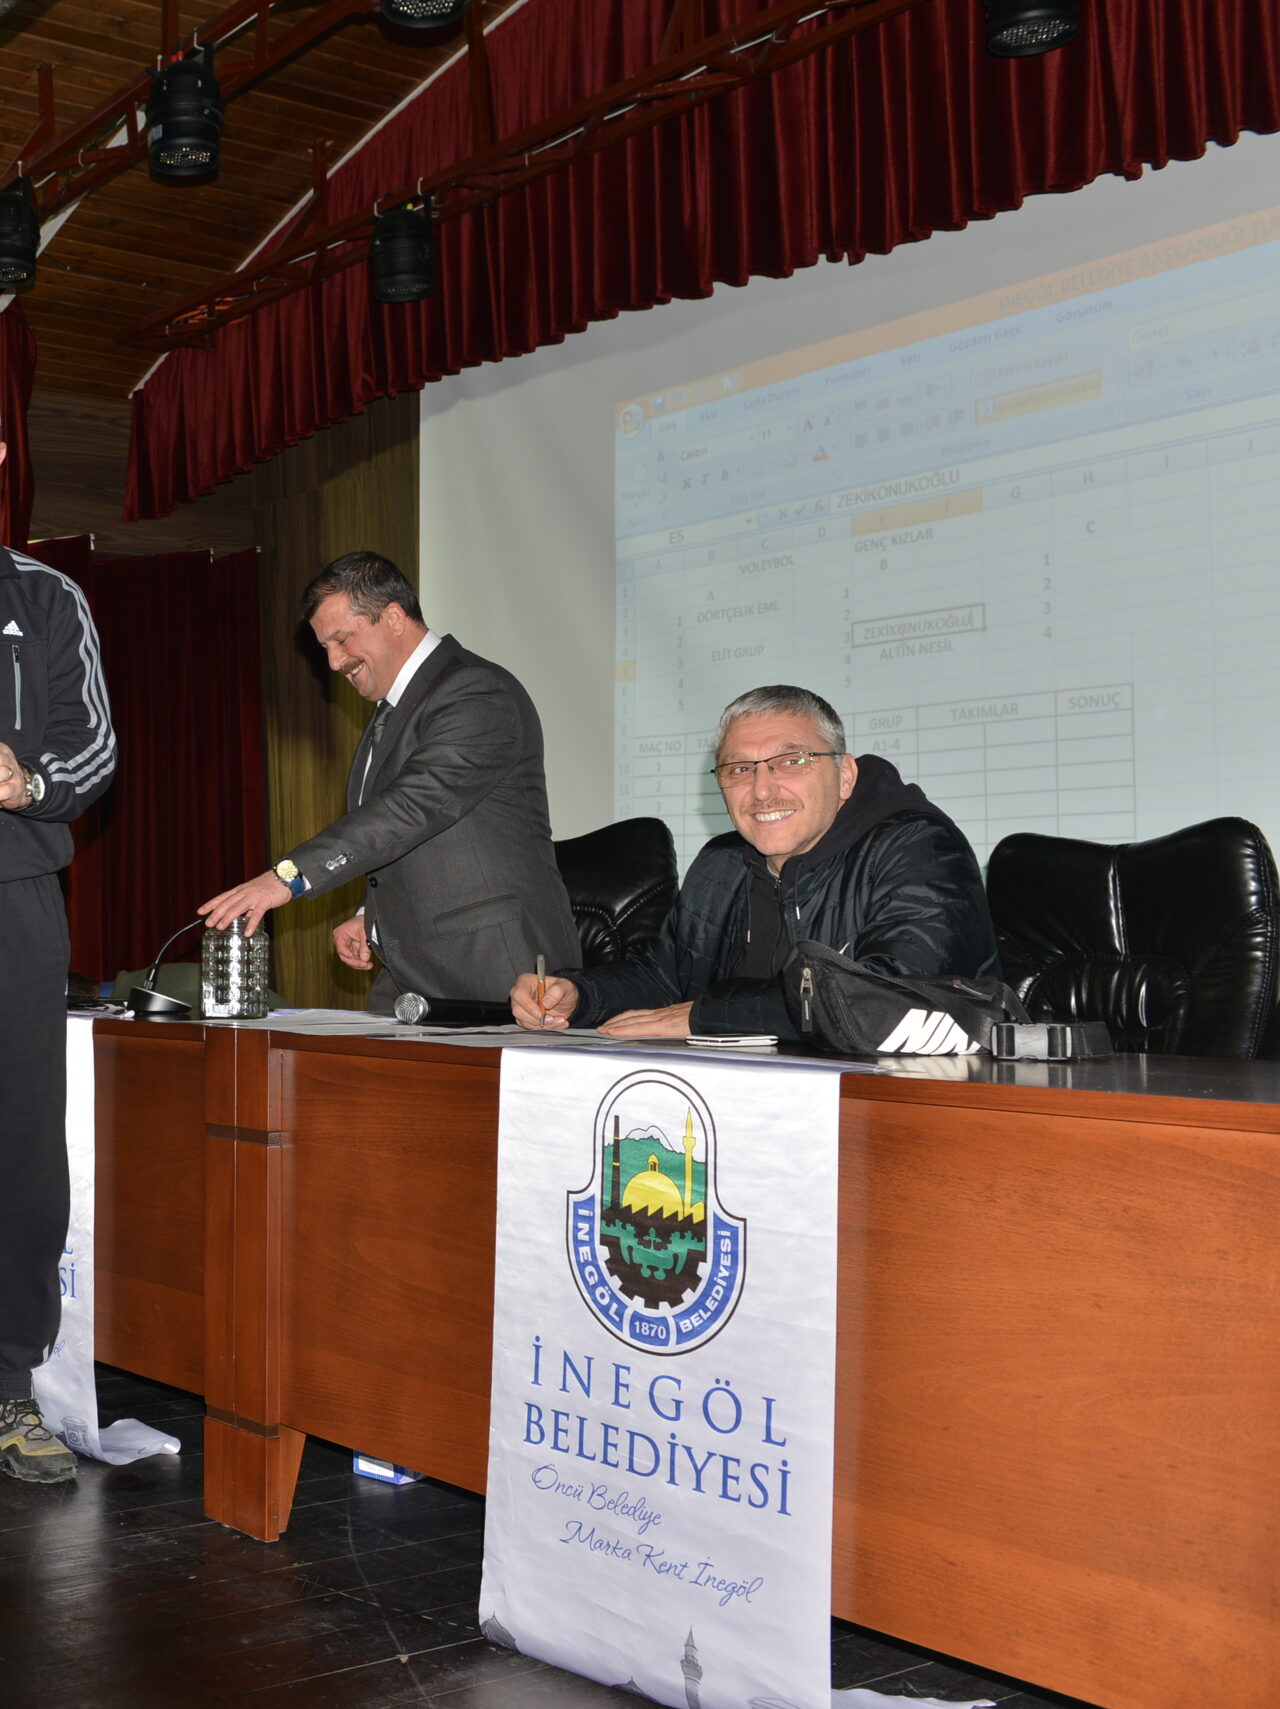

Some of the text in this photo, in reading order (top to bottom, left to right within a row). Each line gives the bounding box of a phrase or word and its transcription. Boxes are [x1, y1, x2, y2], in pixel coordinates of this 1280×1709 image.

[680, 447, 708, 462] Calibri
[837, 468, 960, 509] ZEKİKONUKOĞLU
[1086, 520, 1097, 534] C
[669, 532, 684, 544] E5
[854, 527, 934, 553] GENÇ KIZLAR
[740, 555, 795, 575] VOLEYBOL
[879, 558, 888, 571] B
[706, 591, 715, 602] A
[864, 613, 971, 640] ZEKİKONUKOĞLU
[734, 645, 765, 659] GRUP
[919, 637, 955, 655] NESİL
[1067, 692, 1122, 711] SONUÇ
[869, 715, 903, 729] GRUP
[950, 703, 1019, 722] TAKIMLAR
[639, 741, 681, 756] MAÇ NO
[576, 1208, 621, 1322] İNEGÖL
[678, 1229, 733, 1334] BELEDİYESİ
[633, 1321, 667, 1340] 1870
[531, 1335, 787, 1448] İNEGÖL
[523, 1402, 792, 1516] BELEDİYESİ
[531, 1463, 662, 1535] Öncü Belediye
[560, 1520, 764, 1607] Marka Kent İnegöl
